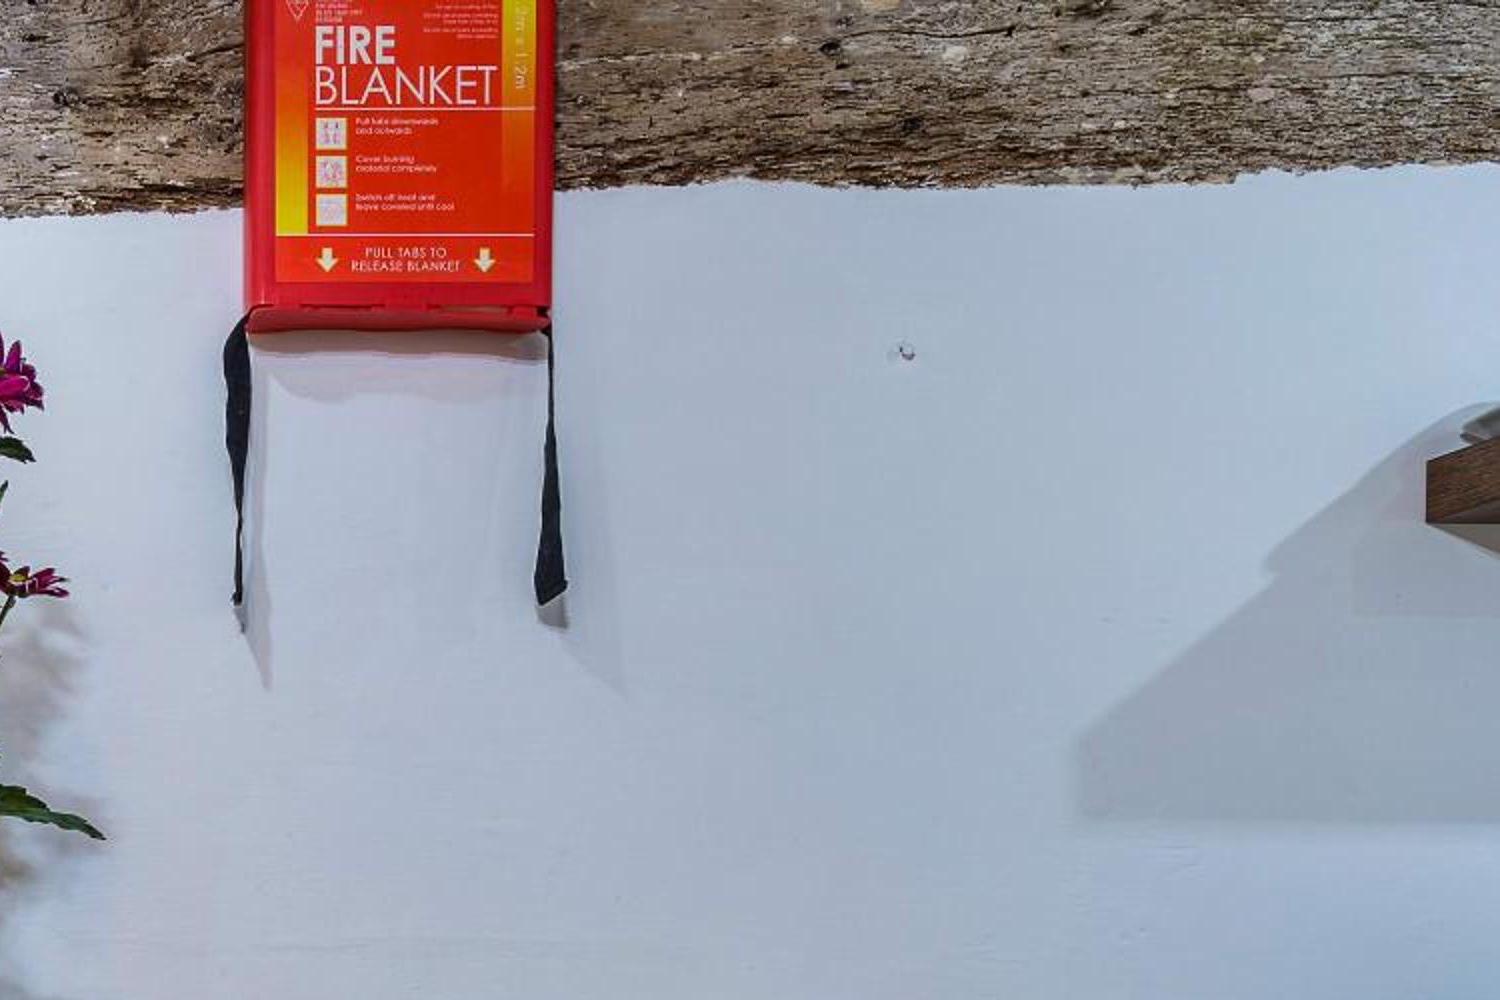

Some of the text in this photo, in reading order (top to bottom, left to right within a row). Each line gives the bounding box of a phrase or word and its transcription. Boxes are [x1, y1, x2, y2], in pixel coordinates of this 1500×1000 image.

[315, 25, 396, 65] FIRE
[315, 65, 498, 106] BLANKET
[351, 260, 460, 272] RELEASE BLANKET
[365, 247, 447, 259] PULL TABS TO
